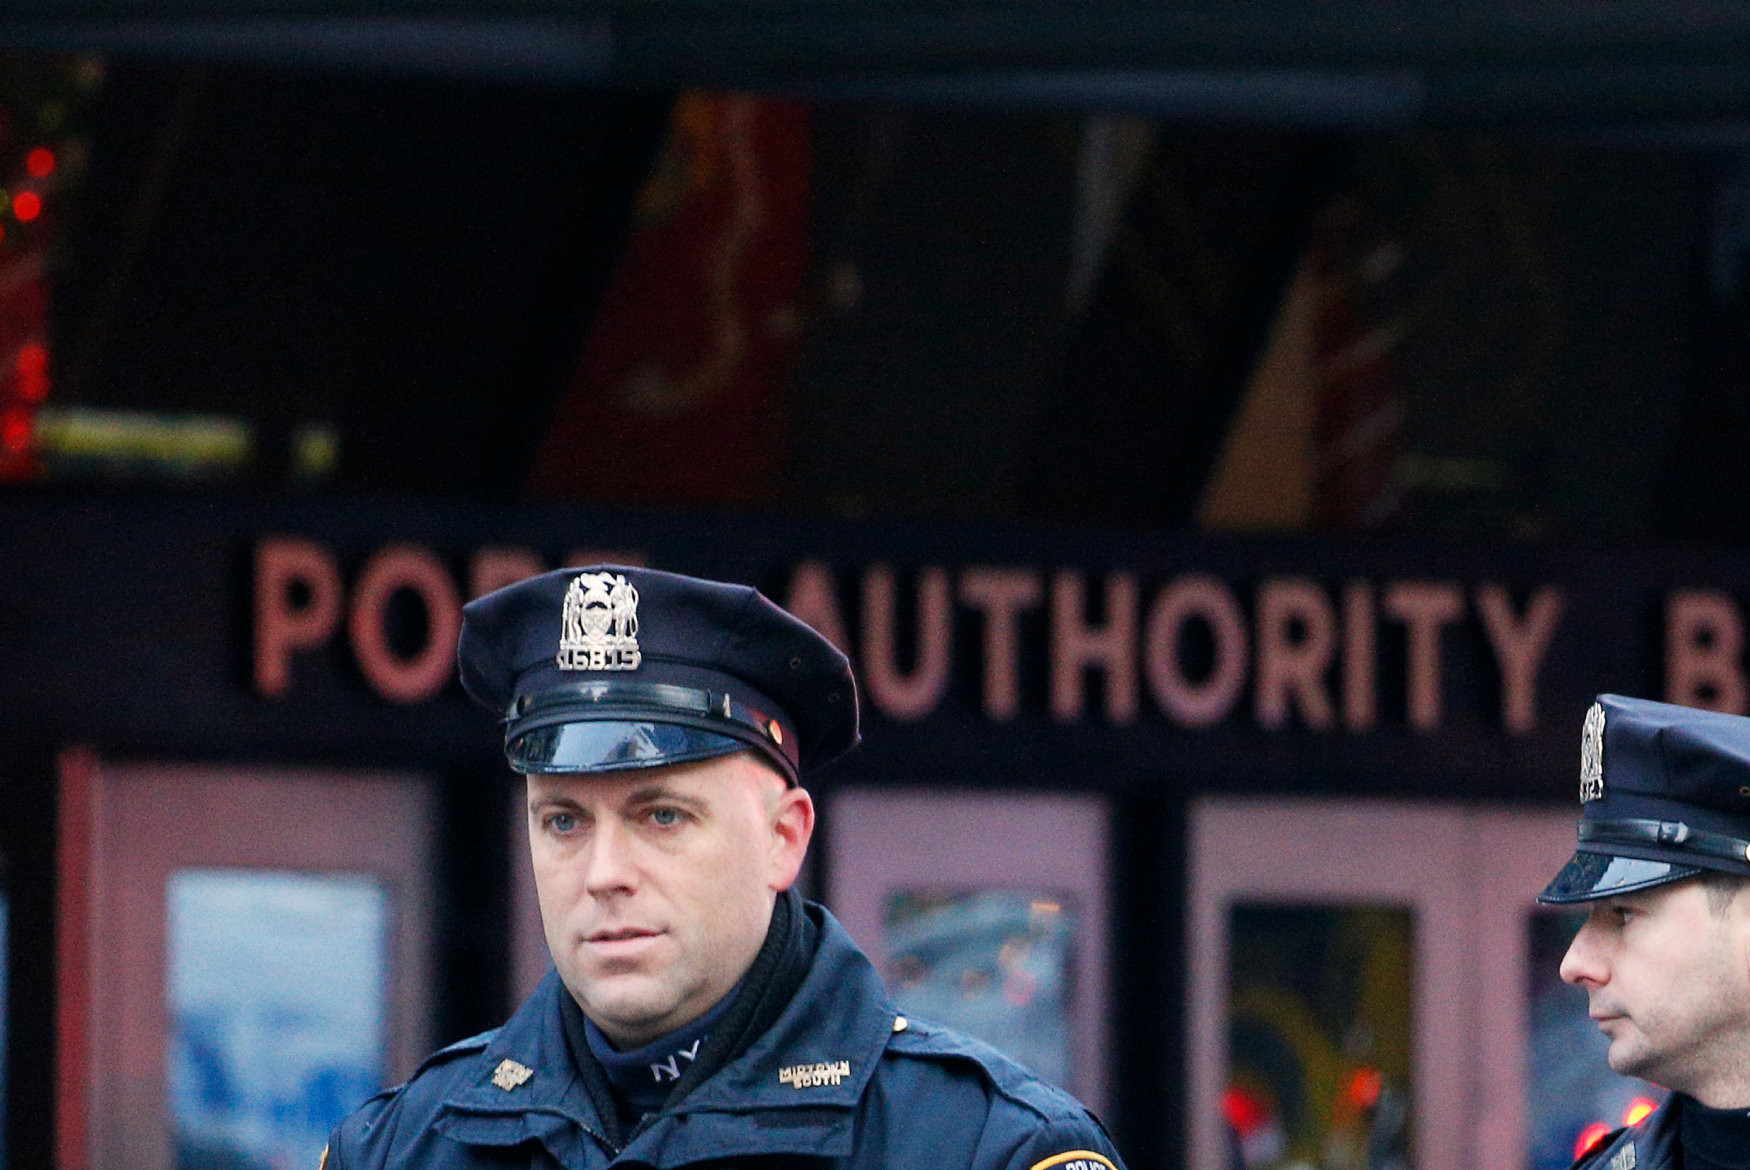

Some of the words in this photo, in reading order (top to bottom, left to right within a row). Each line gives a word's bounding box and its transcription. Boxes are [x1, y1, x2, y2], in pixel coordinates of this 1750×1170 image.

[252, 535, 646, 703] PO
[778, 1060, 851, 1083] MIDTOWN
[793, 1073, 842, 1090] SOUTH
